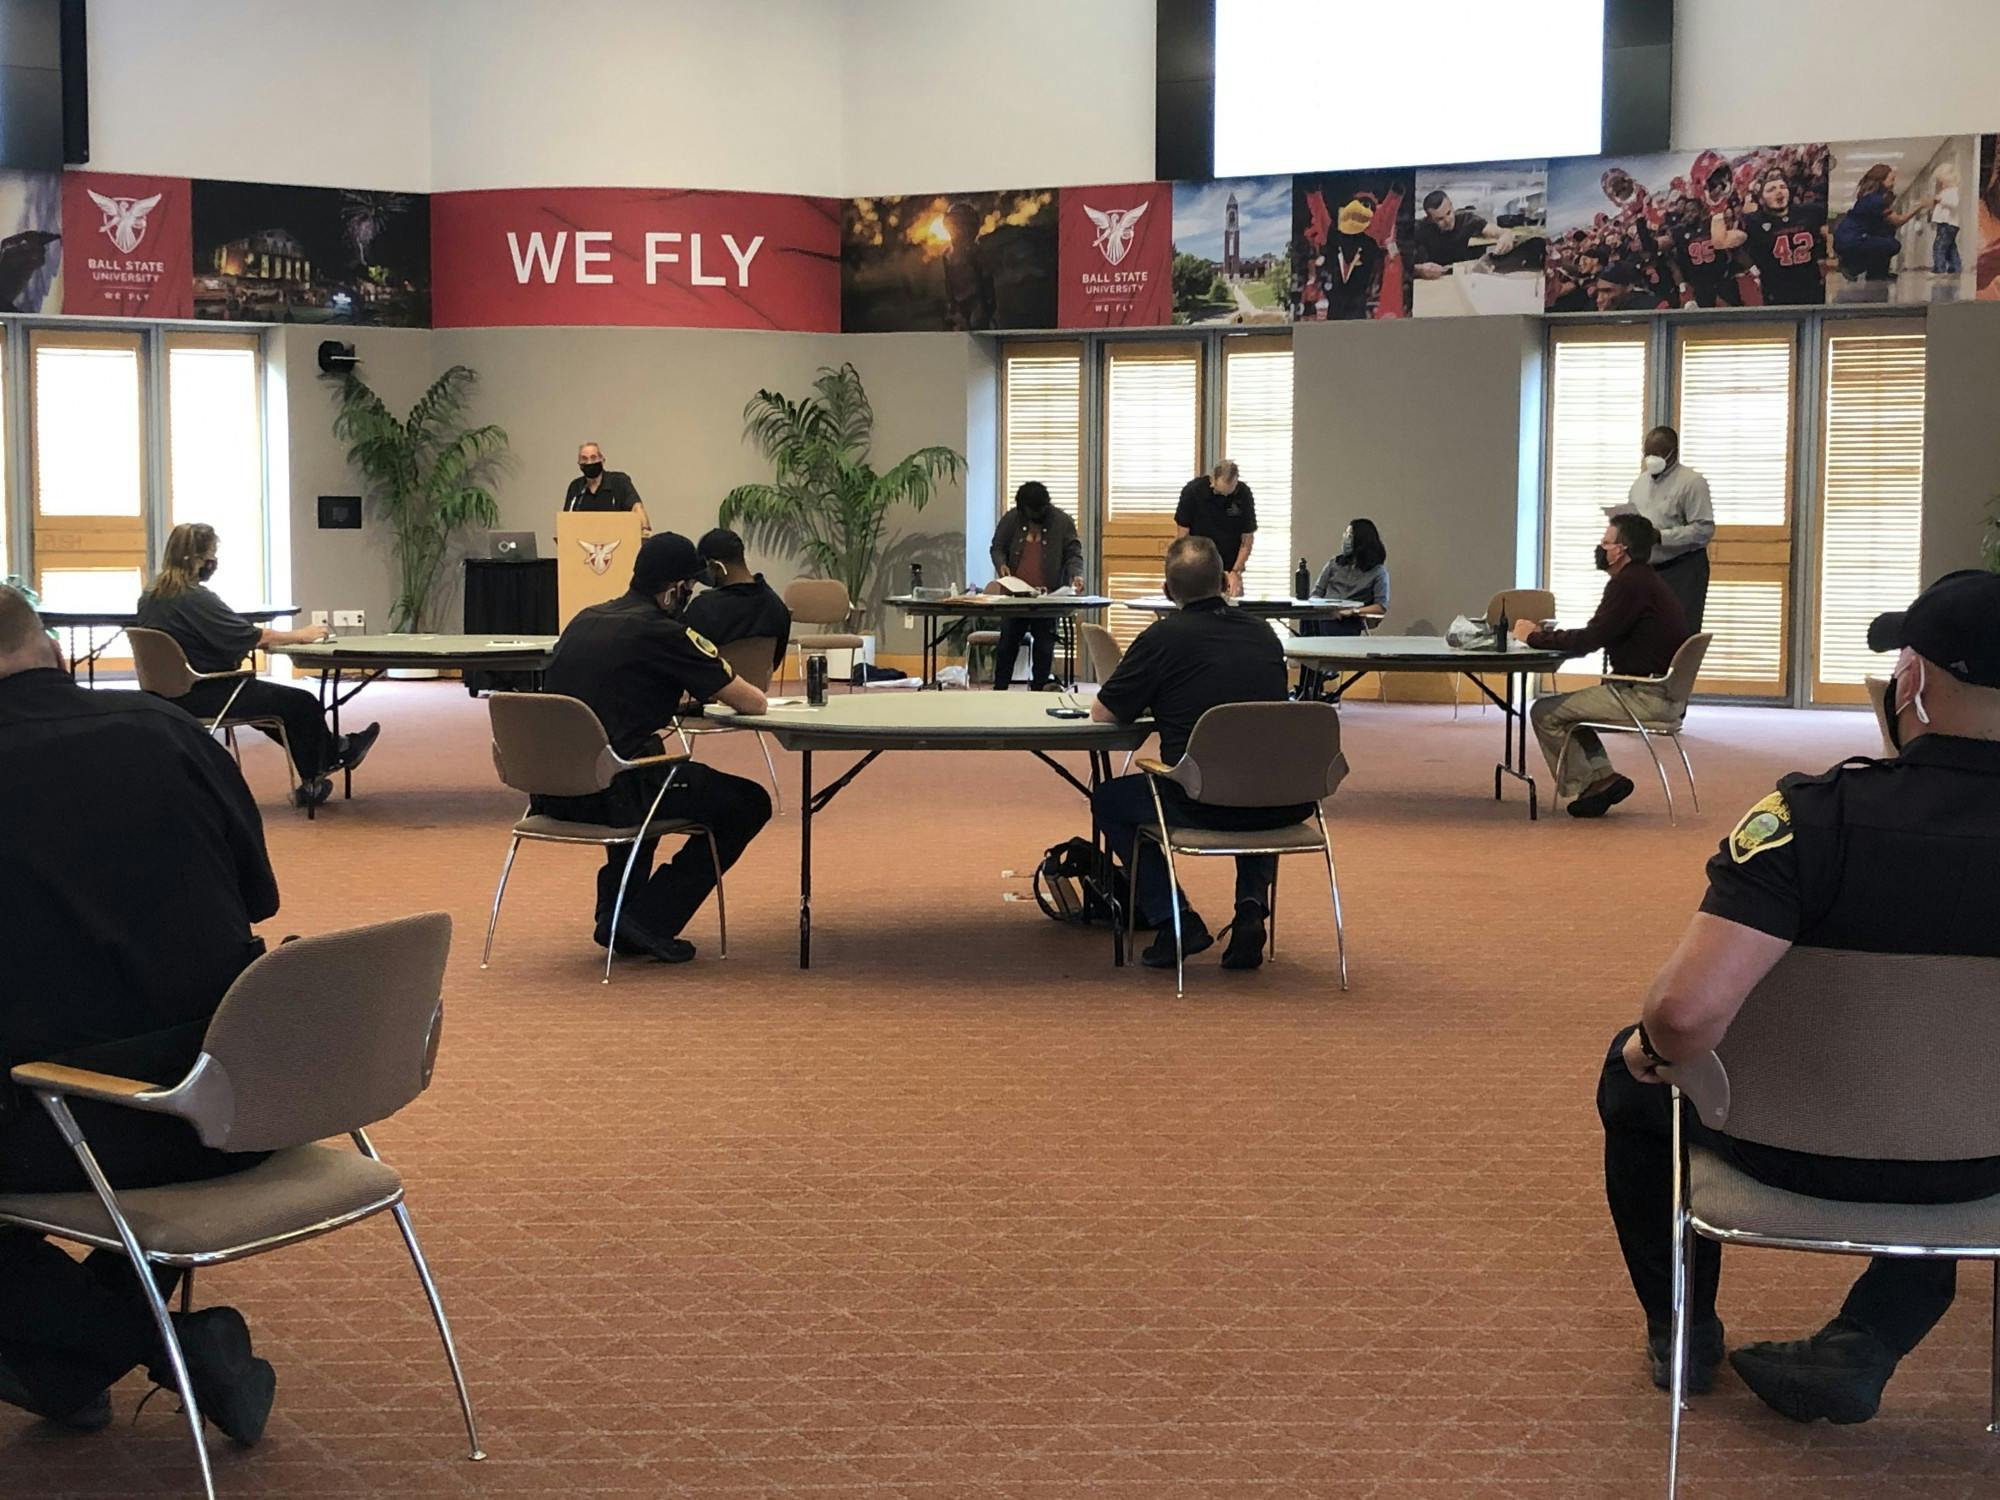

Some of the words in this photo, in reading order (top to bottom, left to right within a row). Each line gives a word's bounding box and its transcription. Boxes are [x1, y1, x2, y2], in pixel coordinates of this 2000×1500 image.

[1773, 232, 1813, 266] 42
[88, 259, 121, 270] BALL
[126, 261, 164, 272] STATE
[506, 231, 614, 284] WE
[645, 231, 765, 288] FLY
[93, 272, 159, 282] UNIVERSITY
[1082, 273, 1110, 283] BALL
[1114, 272, 1148, 282] STATE
[1086, 284, 1144, 294] UNIVERSITY
